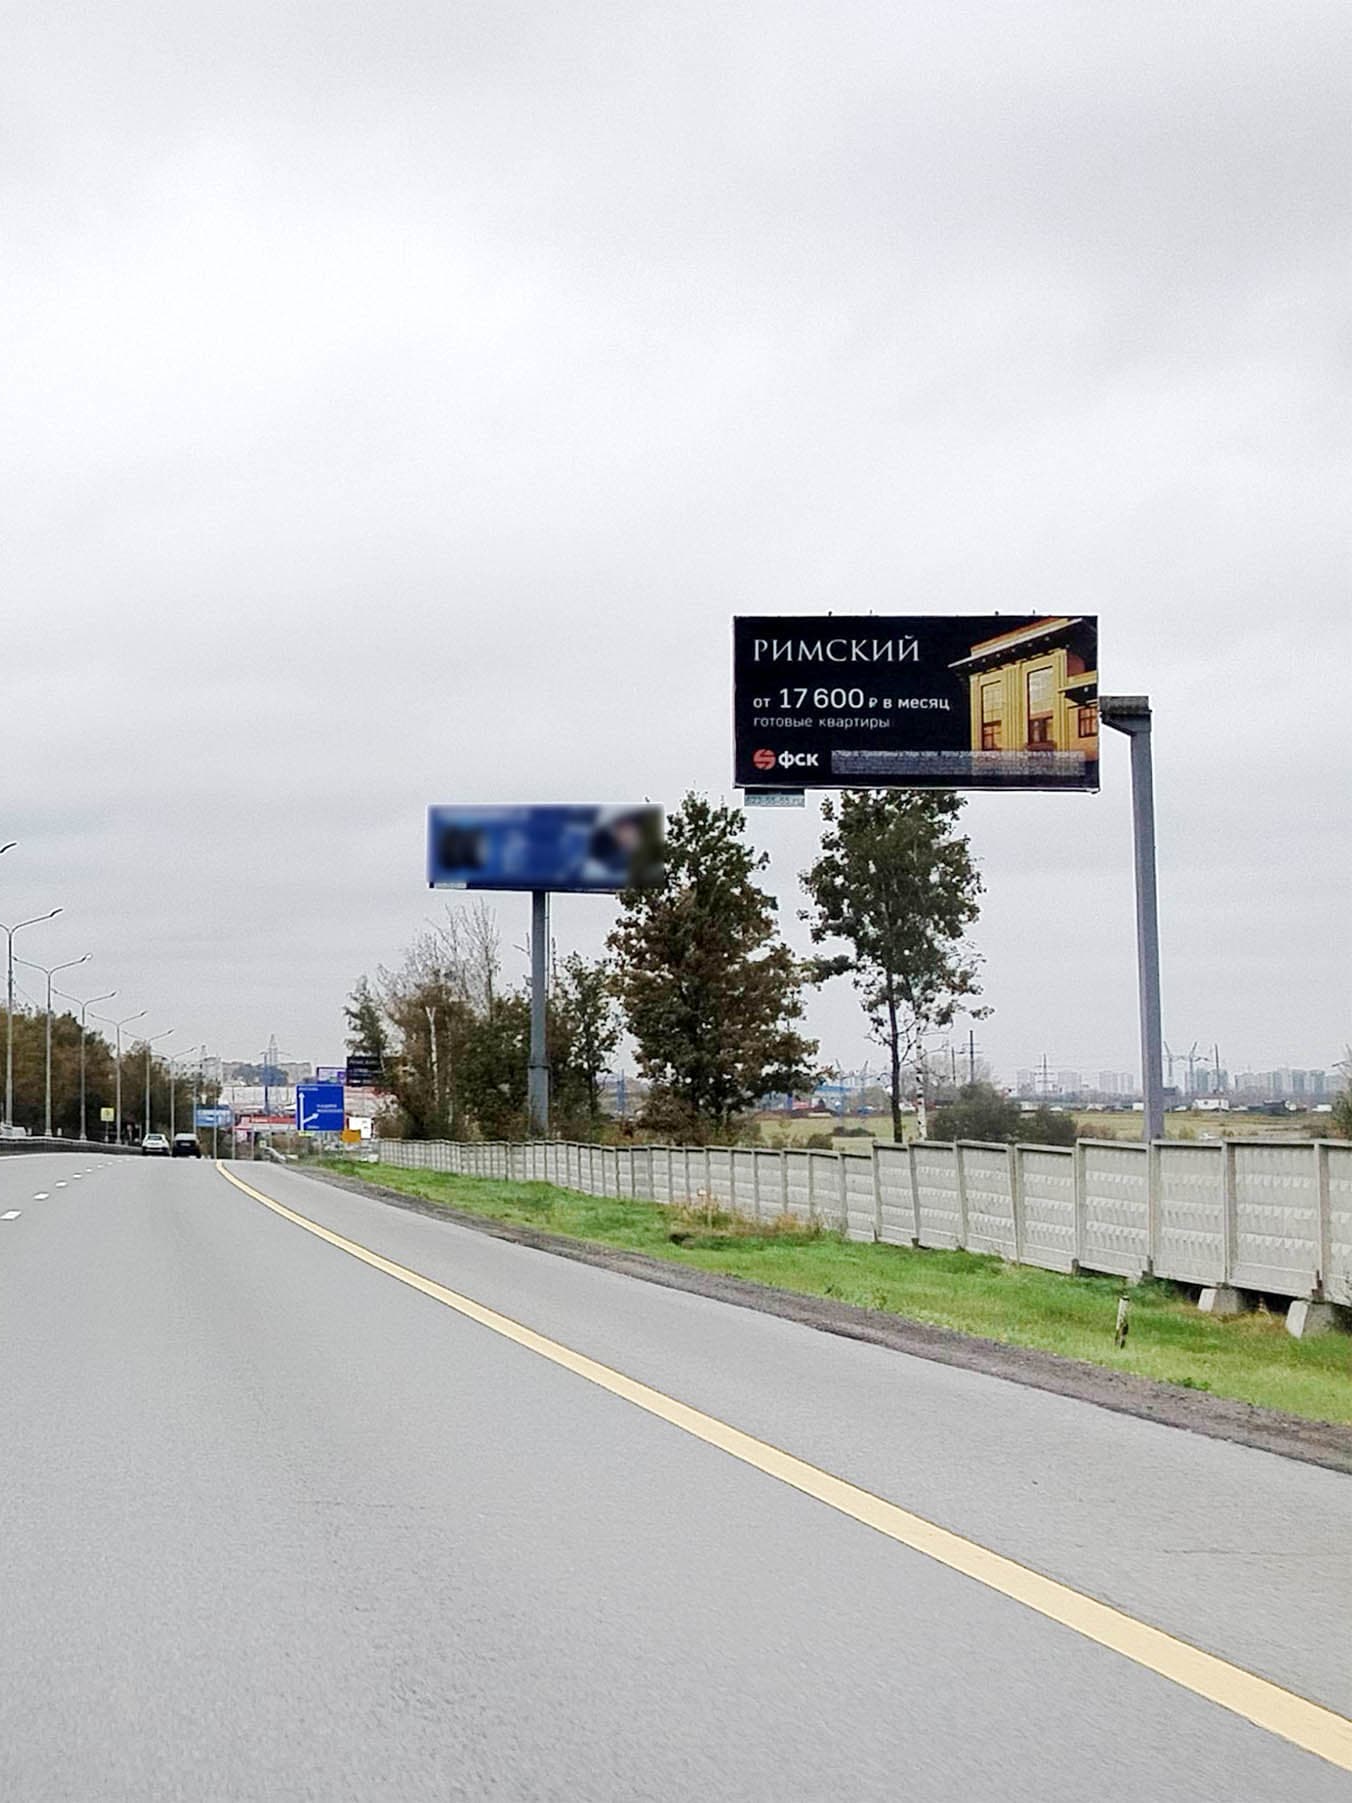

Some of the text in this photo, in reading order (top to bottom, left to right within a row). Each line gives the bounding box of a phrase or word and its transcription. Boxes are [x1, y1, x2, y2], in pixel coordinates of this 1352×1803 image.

[754, 634, 920, 662] РИМСКИЙ
[753, 698, 771, 709] от
[898, 698, 950, 711] месяц
[753, 717, 891, 730] готовые квартиры
